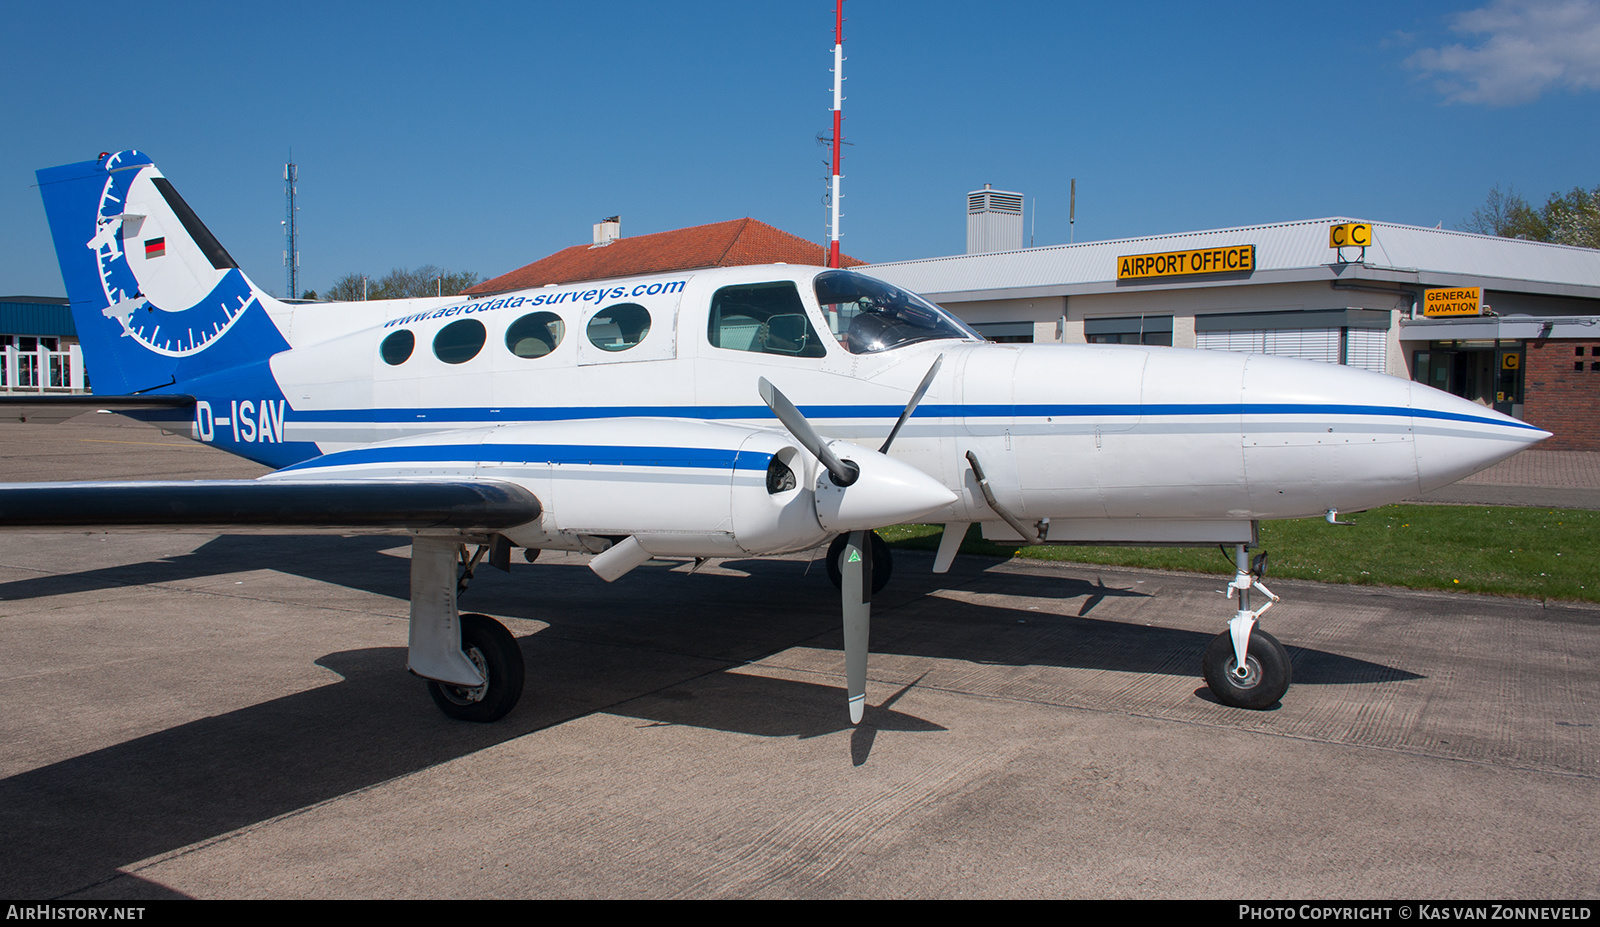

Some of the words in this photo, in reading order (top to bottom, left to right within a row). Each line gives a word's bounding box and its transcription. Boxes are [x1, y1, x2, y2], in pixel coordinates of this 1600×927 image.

[1333, 226, 1344, 245] C
[1352, 225, 1366, 244] C
[1120, 254, 1187, 276] AIRPORT
[1190, 248, 1250, 271] OFFICE
[383, 280, 687, 329] www.aerodata-surveys.com
[1427, 290, 1478, 301] GENERAL
[1427, 302, 1477, 313] AVIATION
[1505, 355, 1516, 368] C
[196, 400, 286, 443] D-ISAV
